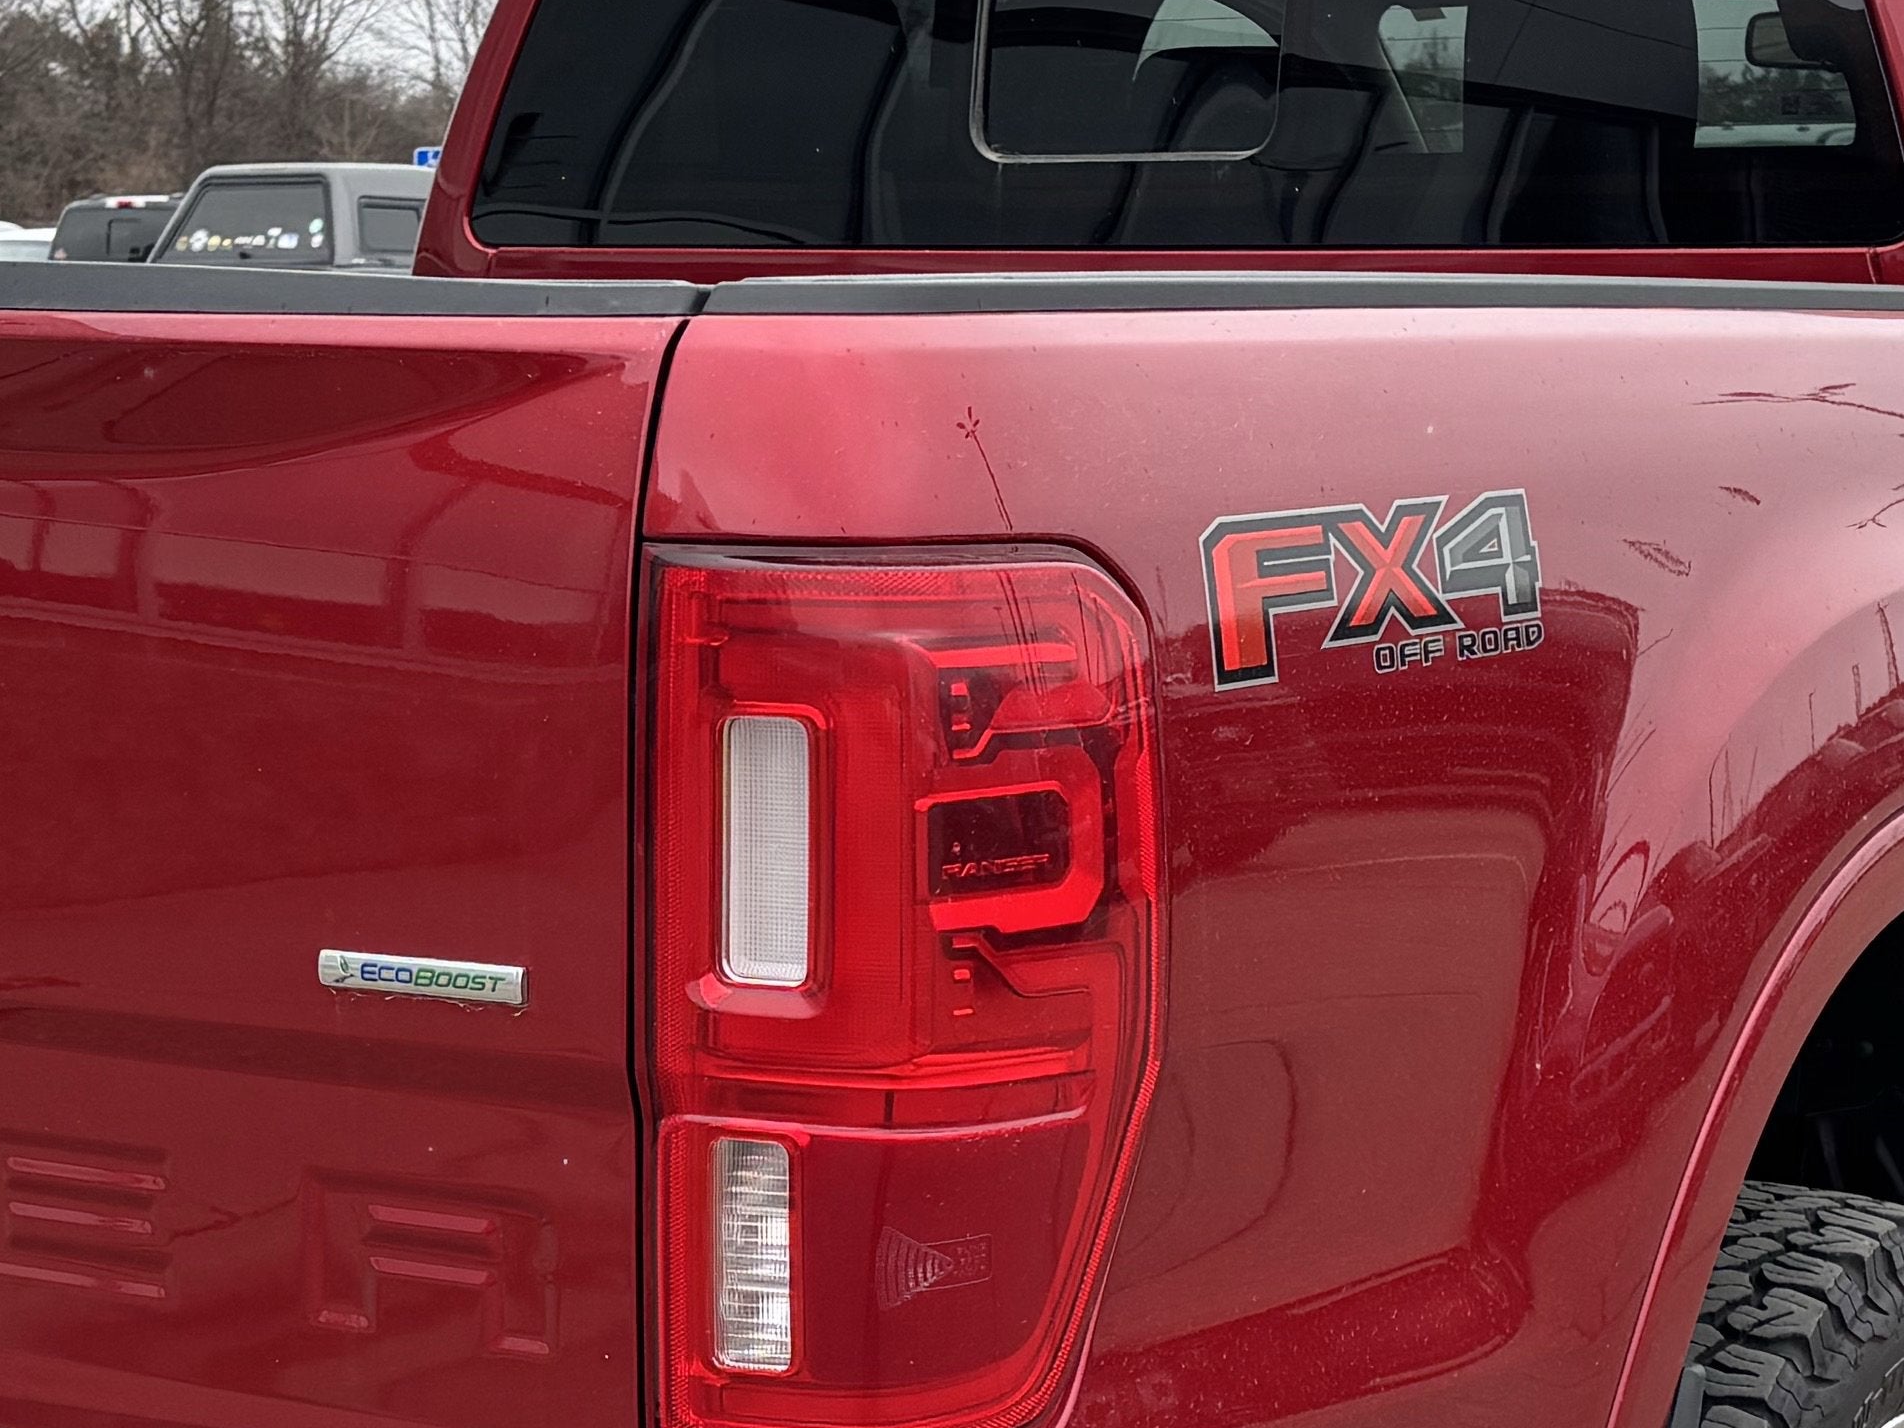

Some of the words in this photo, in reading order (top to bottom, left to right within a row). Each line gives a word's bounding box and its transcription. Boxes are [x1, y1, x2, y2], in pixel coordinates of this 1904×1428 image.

[1199, 488, 1543, 692] FX4
[1373, 636, 1444, 674] OFF
[1456, 621, 1545, 662] ROAD
